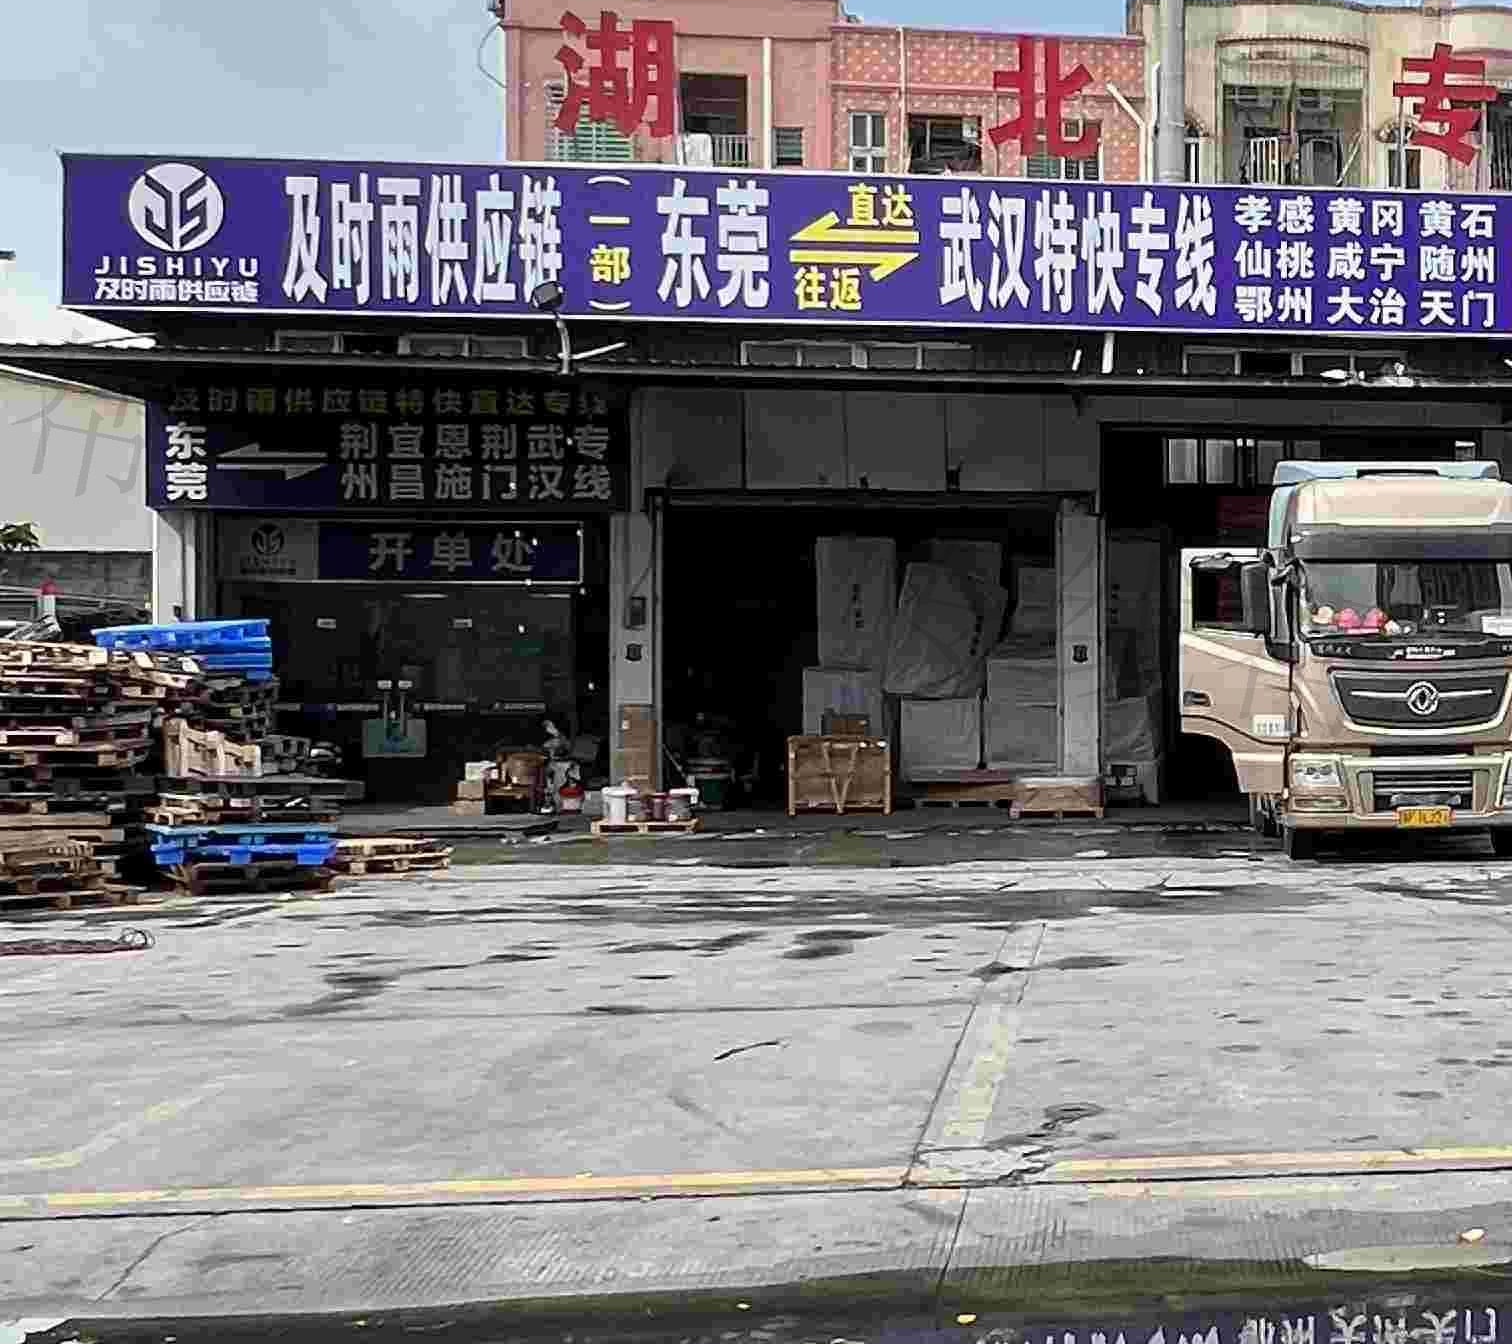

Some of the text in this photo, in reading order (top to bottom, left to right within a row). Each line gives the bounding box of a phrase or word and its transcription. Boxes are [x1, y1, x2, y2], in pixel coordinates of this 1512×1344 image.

[847, 183, 914, 228] 直达
[1233, 194, 1497, 239] 孝感 黄冈 黄石
[281, 172, 564, 306] 及时雨供应链
[656, 179, 770, 309] 东莞
[938, 187, 1218, 316] 武汉特快专线
[1233, 239, 1497, 284] 仙桃 咸宁 随州
[94, 255, 258, 277] JISHIYU
[94, 277, 258, 303] 及时雨供应链
[794, 267, 863, 312] 往返
[1233, 284, 1314, 325] 鄂州
[1418, 289, 1497, 329] 天门
[164, 421, 208, 501] 东莞
[368, 532, 534, 573] 开单处
